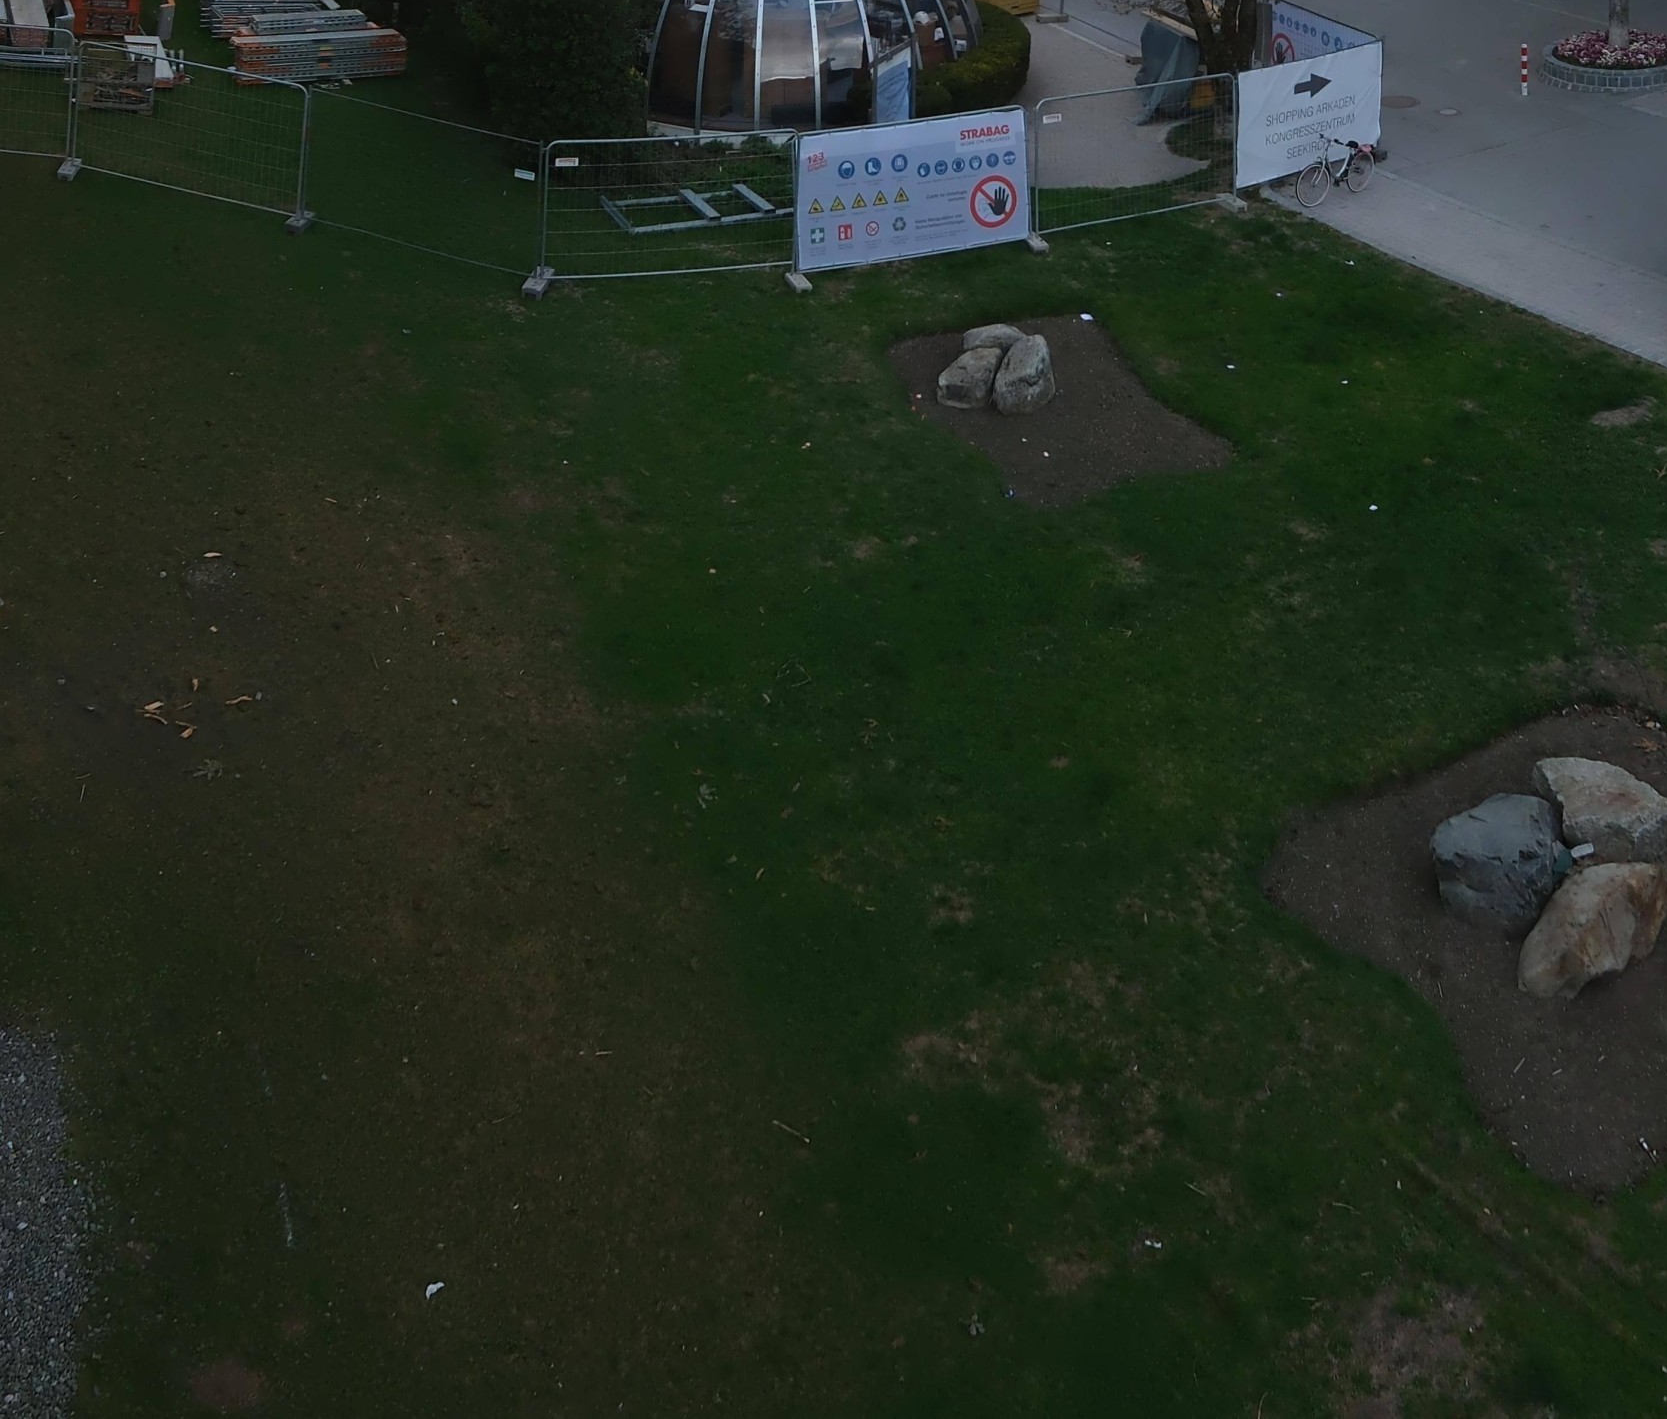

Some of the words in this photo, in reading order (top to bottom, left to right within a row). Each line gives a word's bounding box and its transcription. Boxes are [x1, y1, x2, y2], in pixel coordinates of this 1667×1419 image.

[1265, 106, 1314, 127] SHOPPING
[1315, 95, 1356, 116] ARKADEN
[960, 124, 1010, 140] STRABAG
[1265, 113, 1356, 145] KONGRESSZENTRUM
